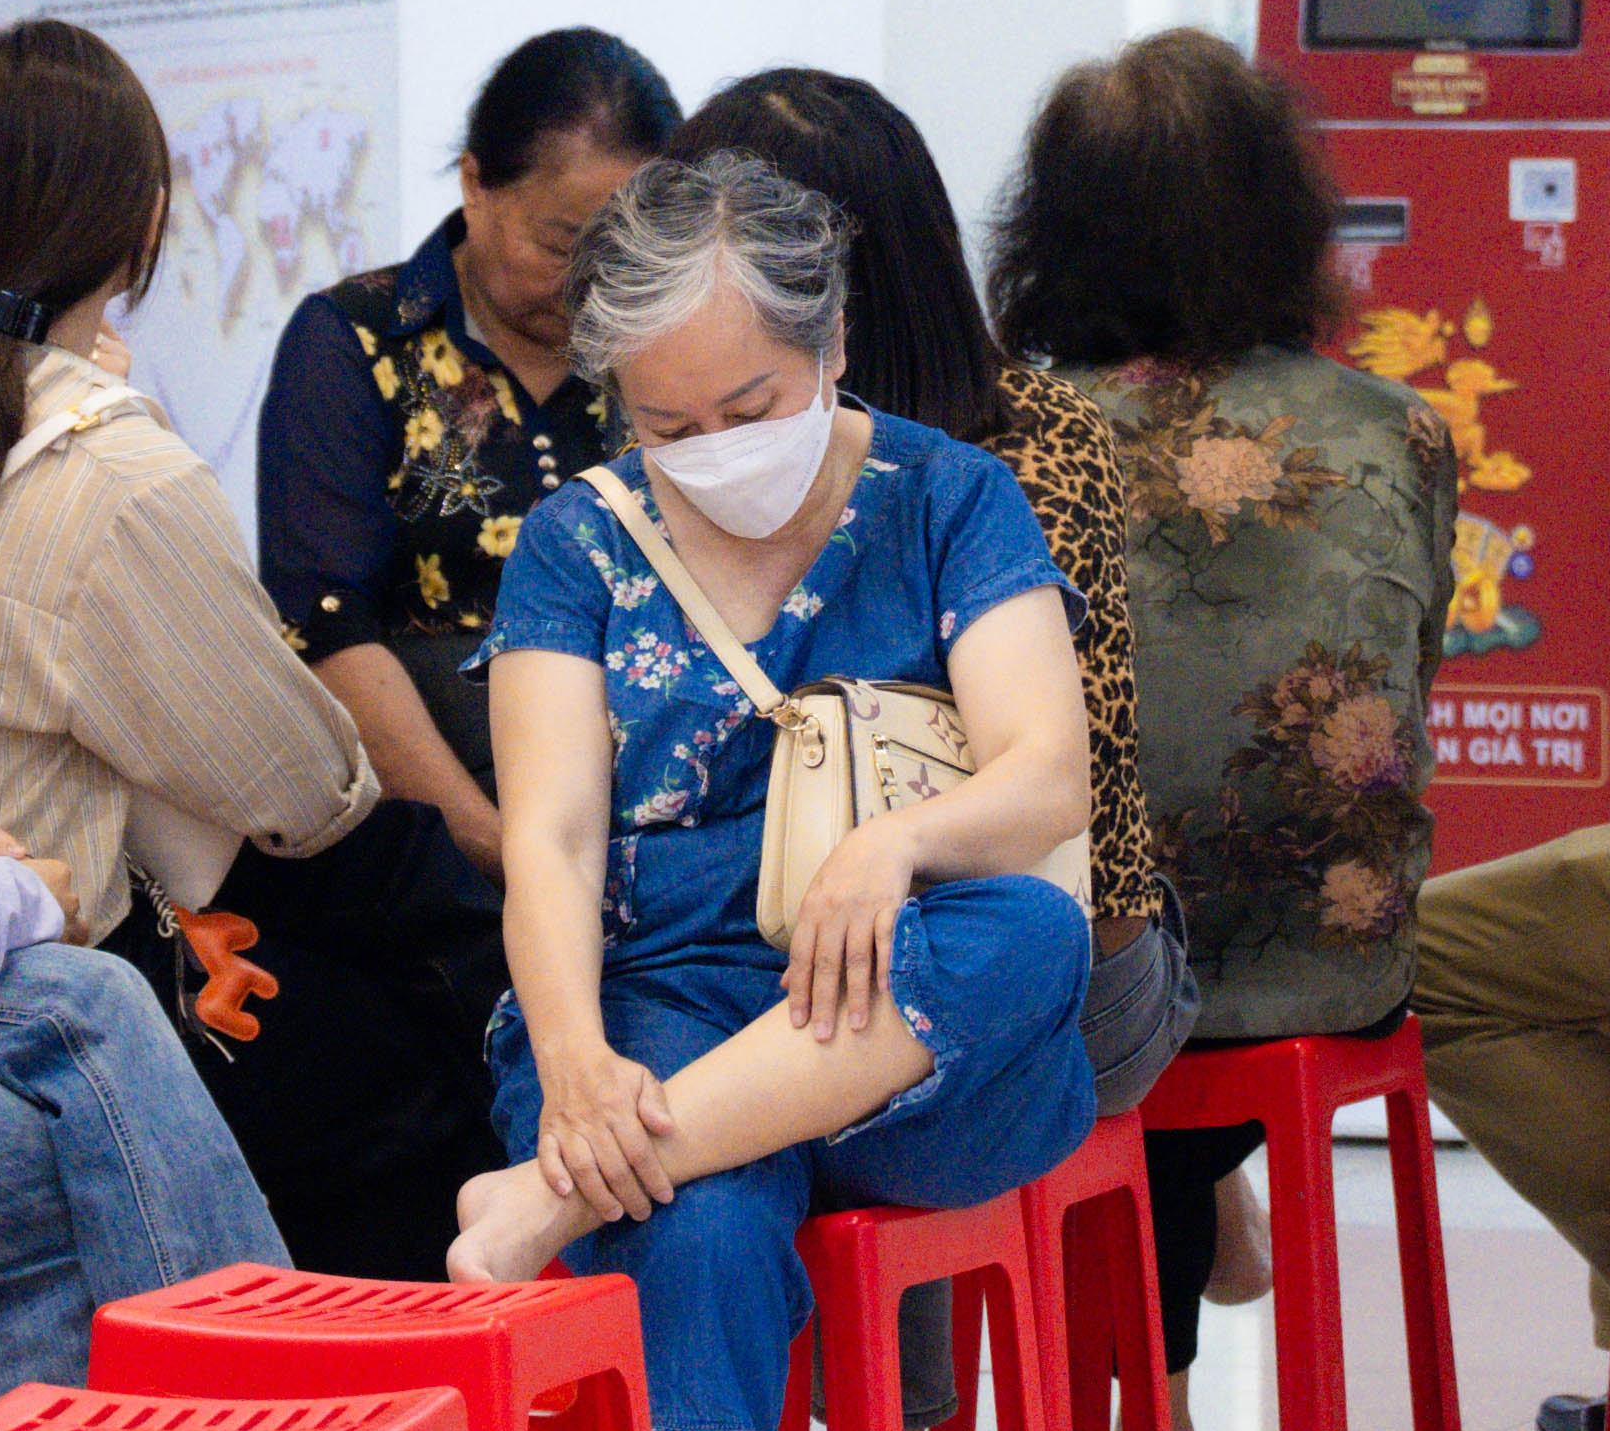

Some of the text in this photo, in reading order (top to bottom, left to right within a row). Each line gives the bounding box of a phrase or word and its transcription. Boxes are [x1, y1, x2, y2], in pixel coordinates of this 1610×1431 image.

[1463, 701, 1588, 733] MỌI NƠI
[1469, 734, 1585, 772] GIÁ TRỊ
